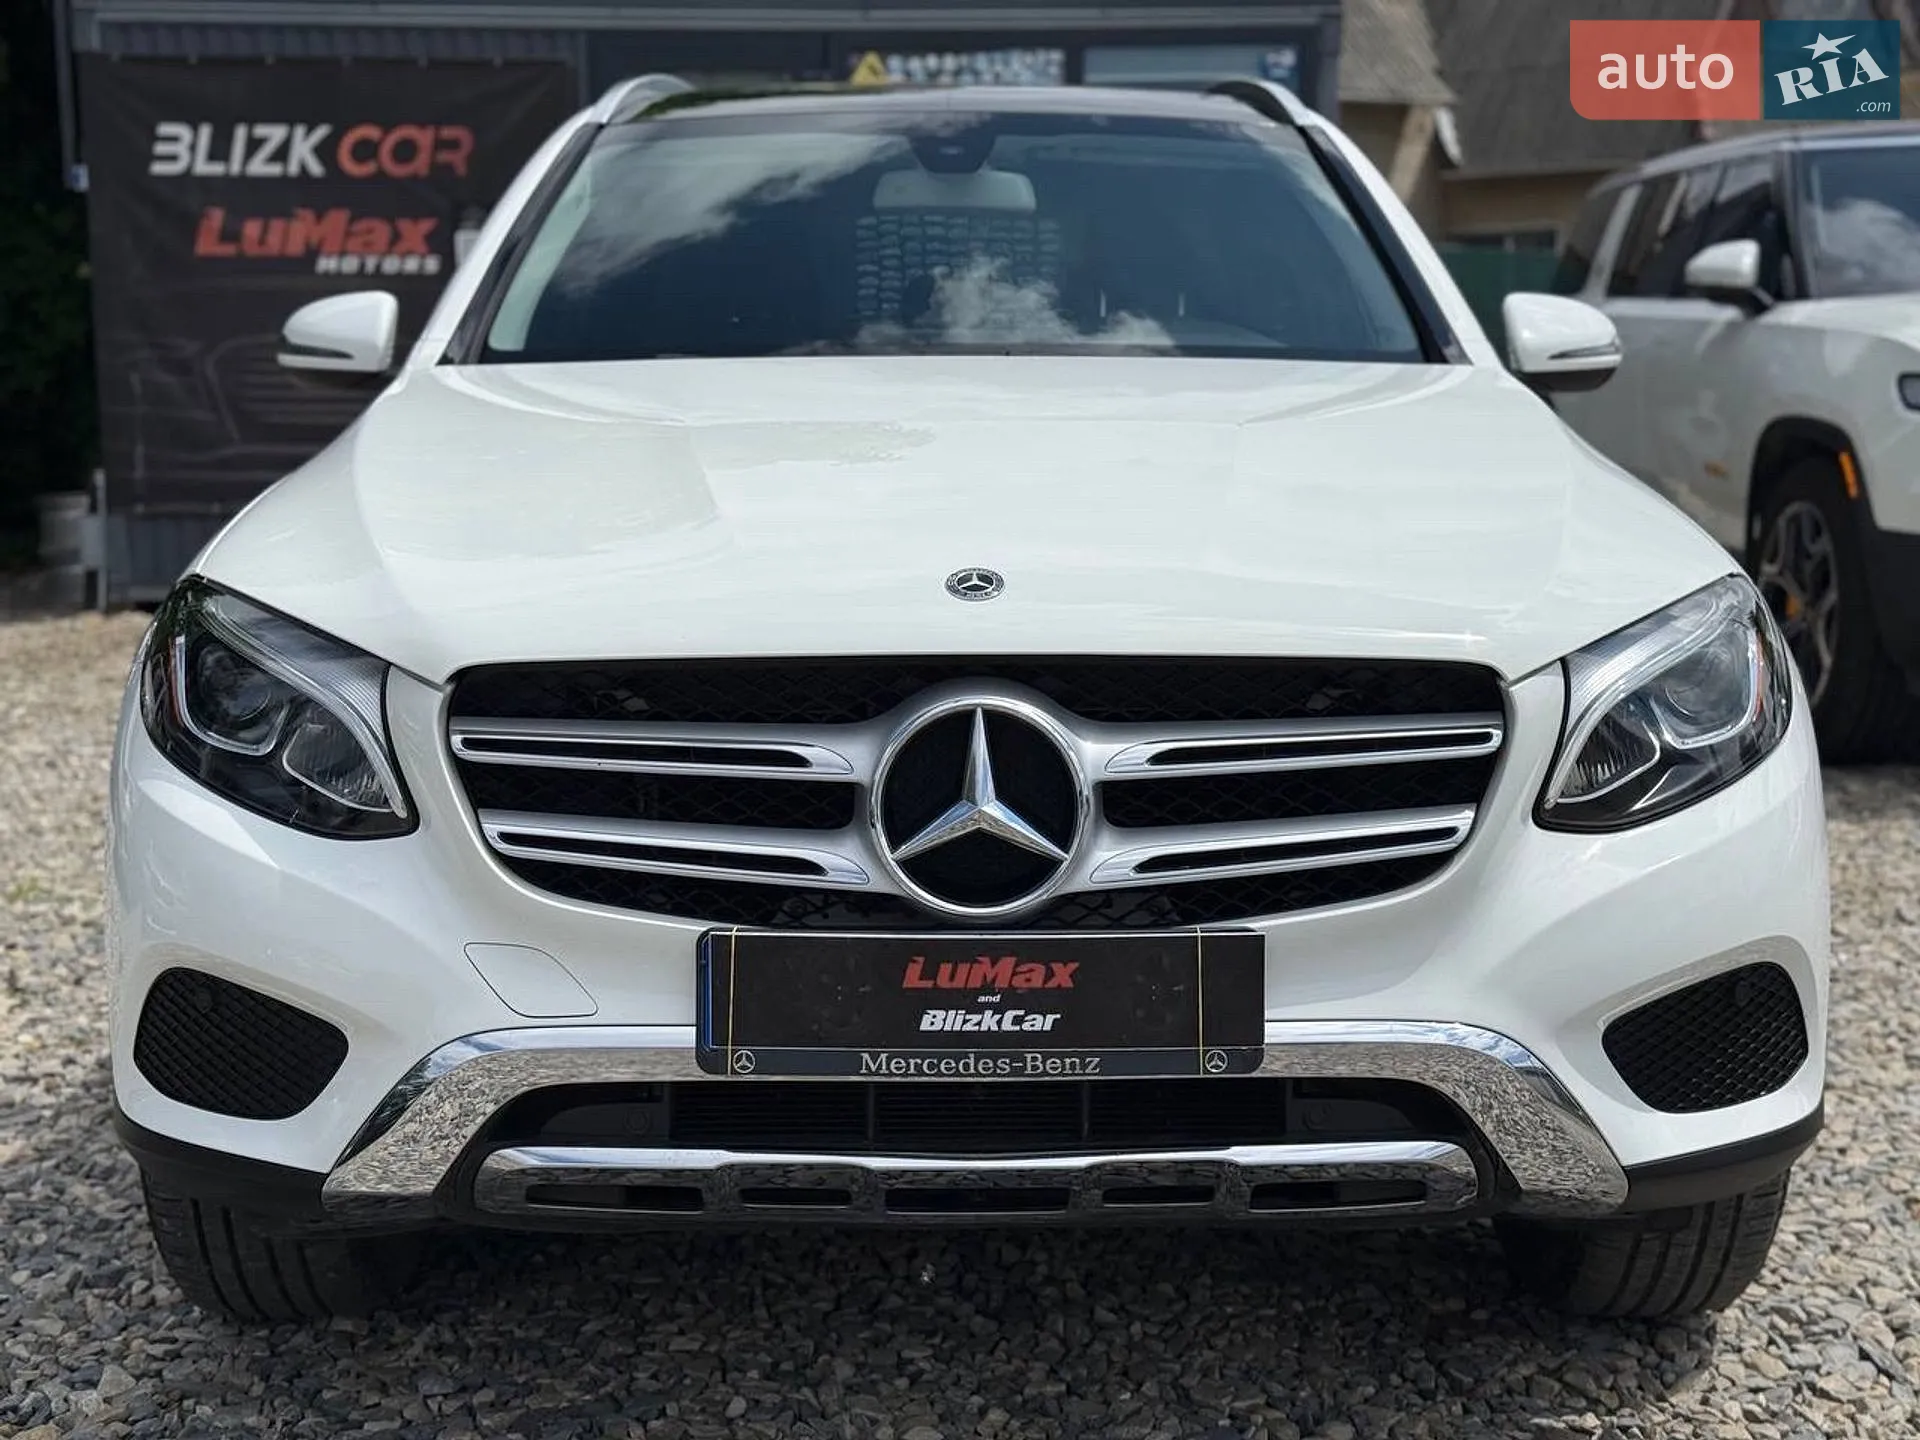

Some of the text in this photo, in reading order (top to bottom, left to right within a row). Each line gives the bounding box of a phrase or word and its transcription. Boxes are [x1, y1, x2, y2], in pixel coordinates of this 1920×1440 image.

[149, 121, 333, 177] BLIZK
[193, 206, 438, 257] LuMax
[315, 255, 441, 274] MOTORS
[902, 956, 1079, 989] LuMax
[977, 994, 1001, 1003] and
[919, 1009, 1061, 1032] BlizkCar
[859, 1053, 1101, 1074] Mercedes-Benz
